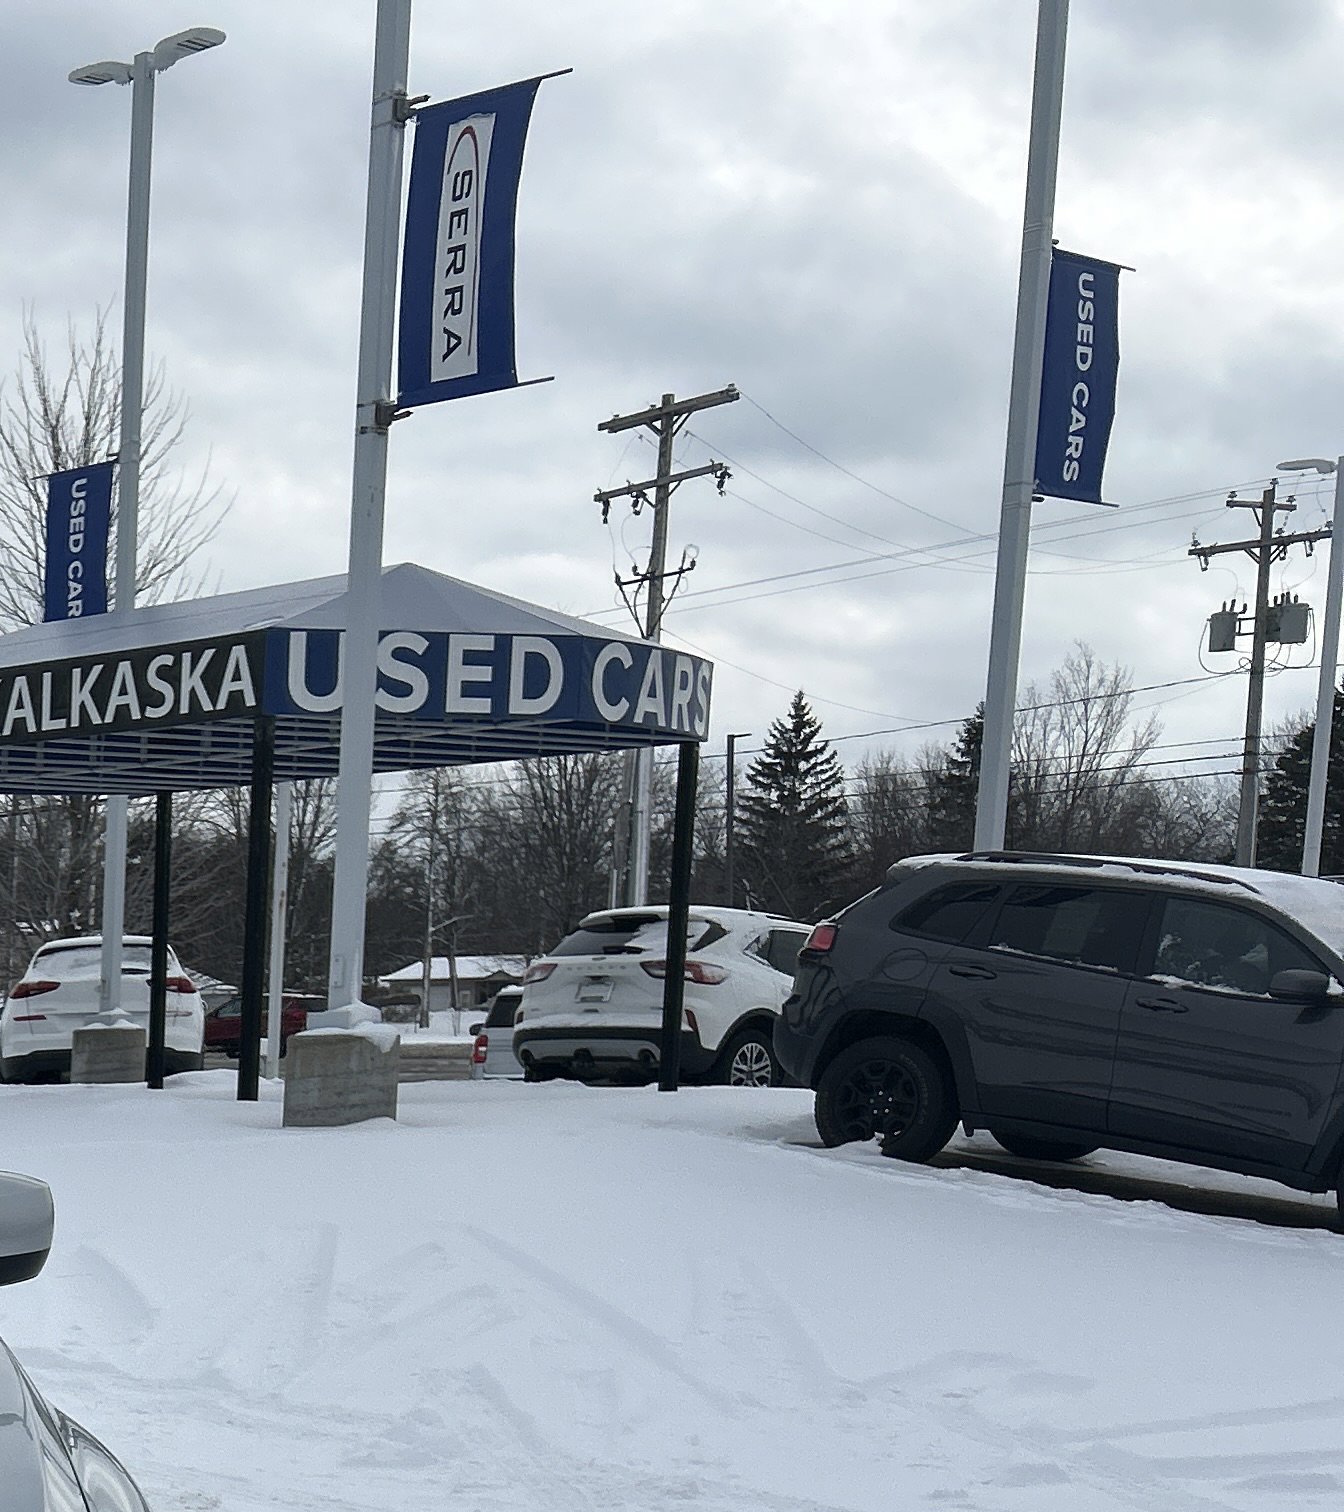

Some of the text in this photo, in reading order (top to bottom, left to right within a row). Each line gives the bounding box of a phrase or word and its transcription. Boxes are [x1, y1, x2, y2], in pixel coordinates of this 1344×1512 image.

[441, 168, 473, 363] SERRA
[1062, 271, 1095, 483] USED CARS
[66, 477, 88, 618] USED CAR
[287, 630, 711, 738] USED CARS
